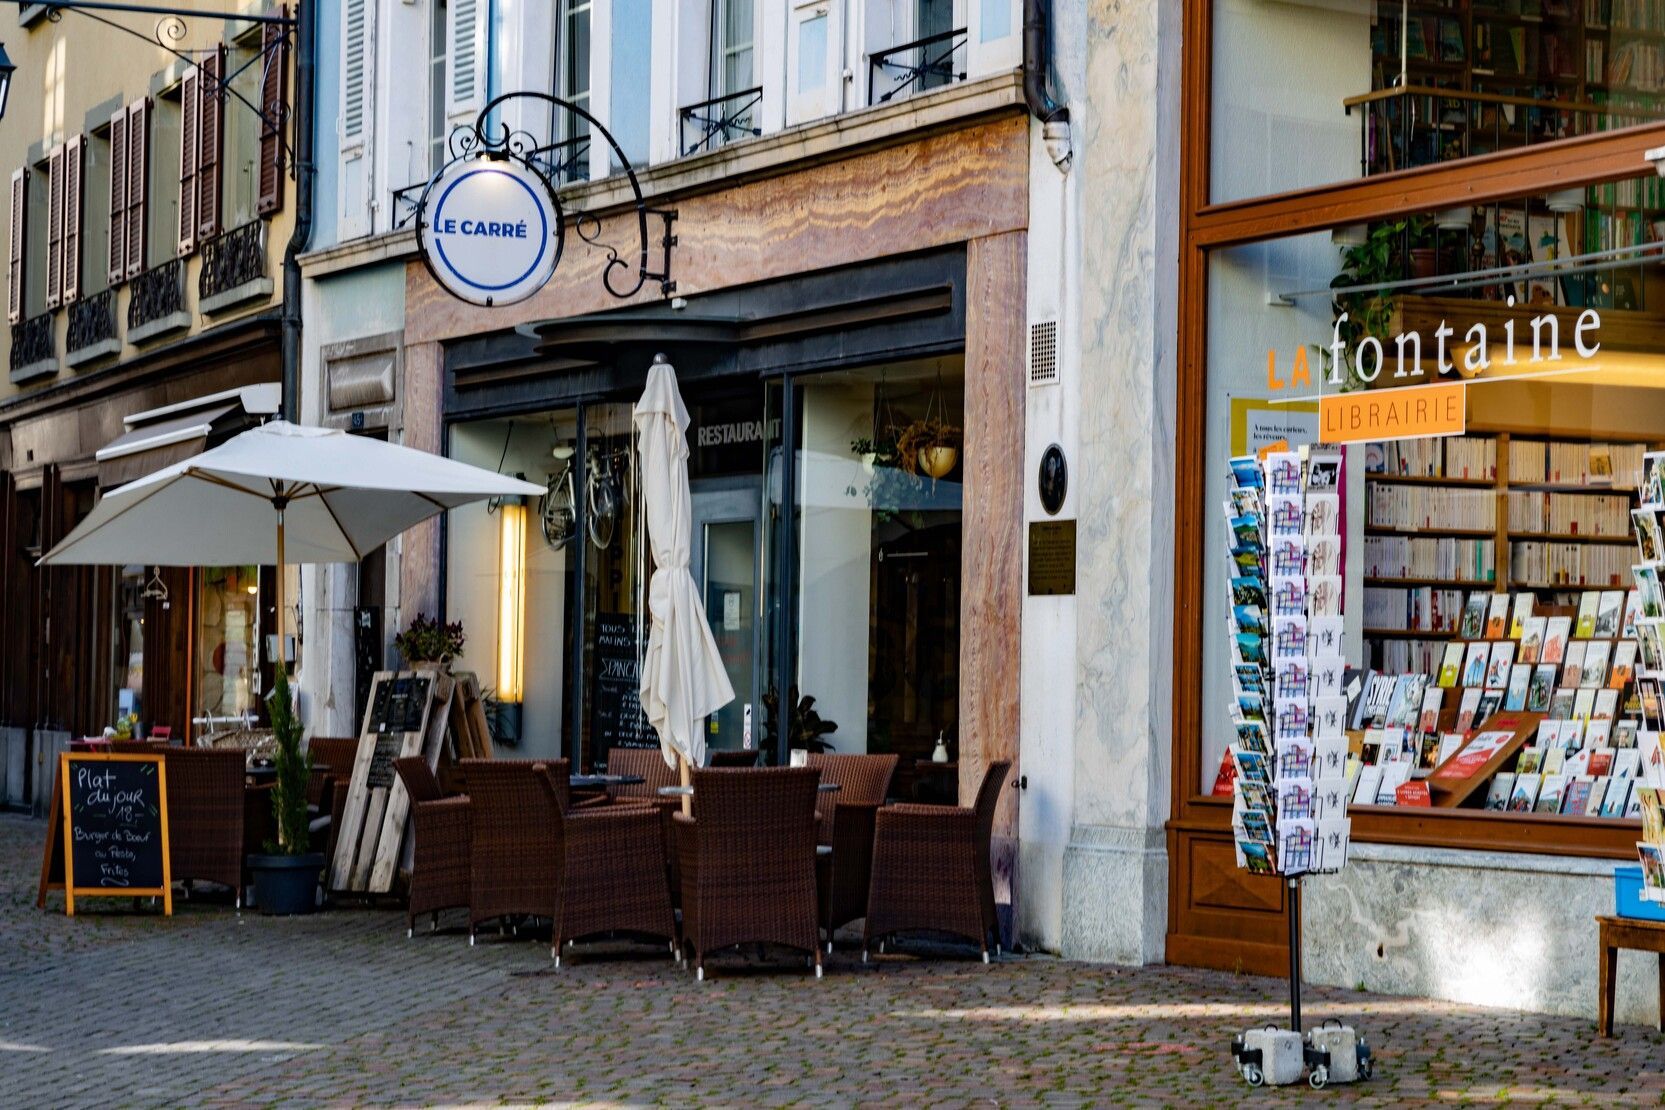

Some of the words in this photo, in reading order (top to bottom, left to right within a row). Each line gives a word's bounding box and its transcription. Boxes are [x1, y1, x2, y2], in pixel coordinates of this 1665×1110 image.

[433, 219, 457, 235] LE
[460, 219, 528, 239] CARRÉ
[1267, 343, 1312, 391] LA
[1328, 294, 1602, 386] fontaine
[1326, 396, 1458, 433] LIBRAIRIE
[697, 418, 782, 447] RESTAURANT
[78, 767, 117, 789] Plat
[87, 788, 110, 806] du
[73, 826, 109, 845] Burger
[111, 828, 122, 841] de
[100, 863, 129, 878] Frites
